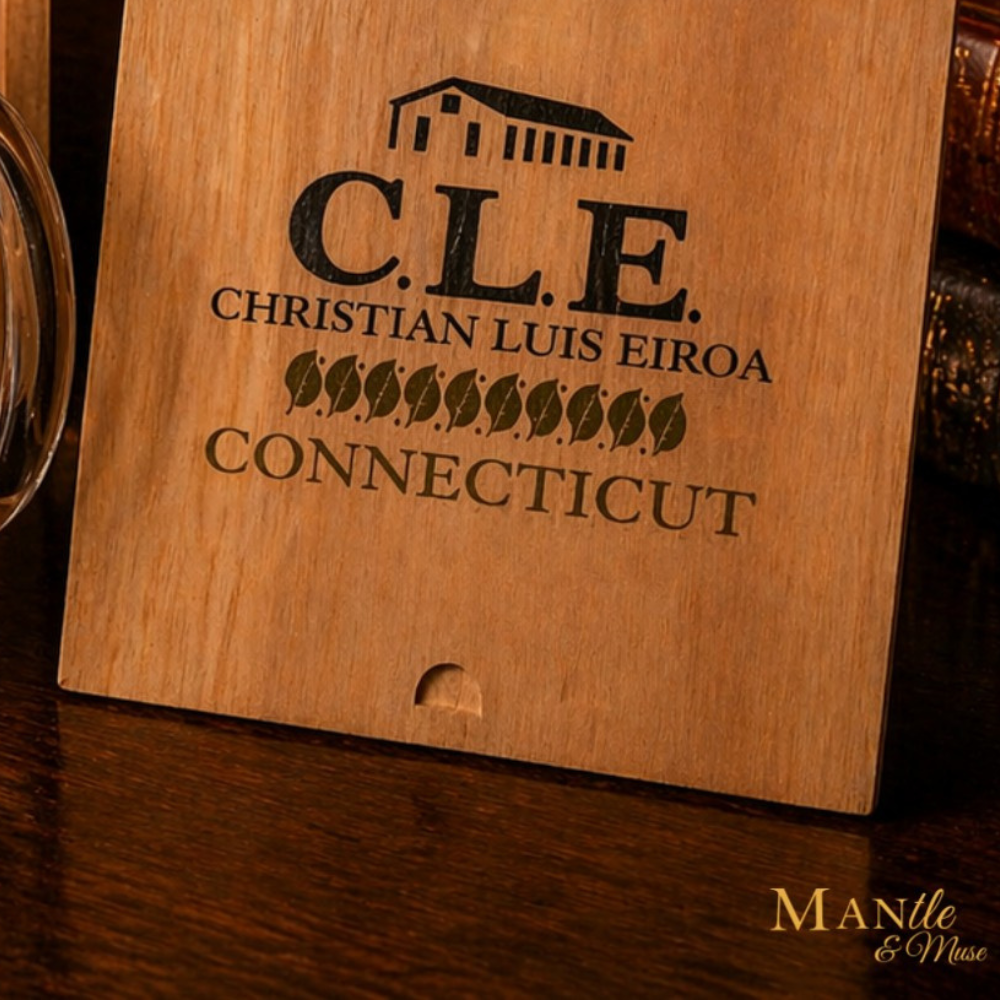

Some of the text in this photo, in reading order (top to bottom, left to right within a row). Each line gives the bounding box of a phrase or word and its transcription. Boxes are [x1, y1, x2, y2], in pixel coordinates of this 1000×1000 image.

[288, 170, 702, 325] C.L.E.
[210, 286, 774, 384] CHRISTIAN LUIS EIROA
[204, 427, 757, 537] CONNECTICUT
